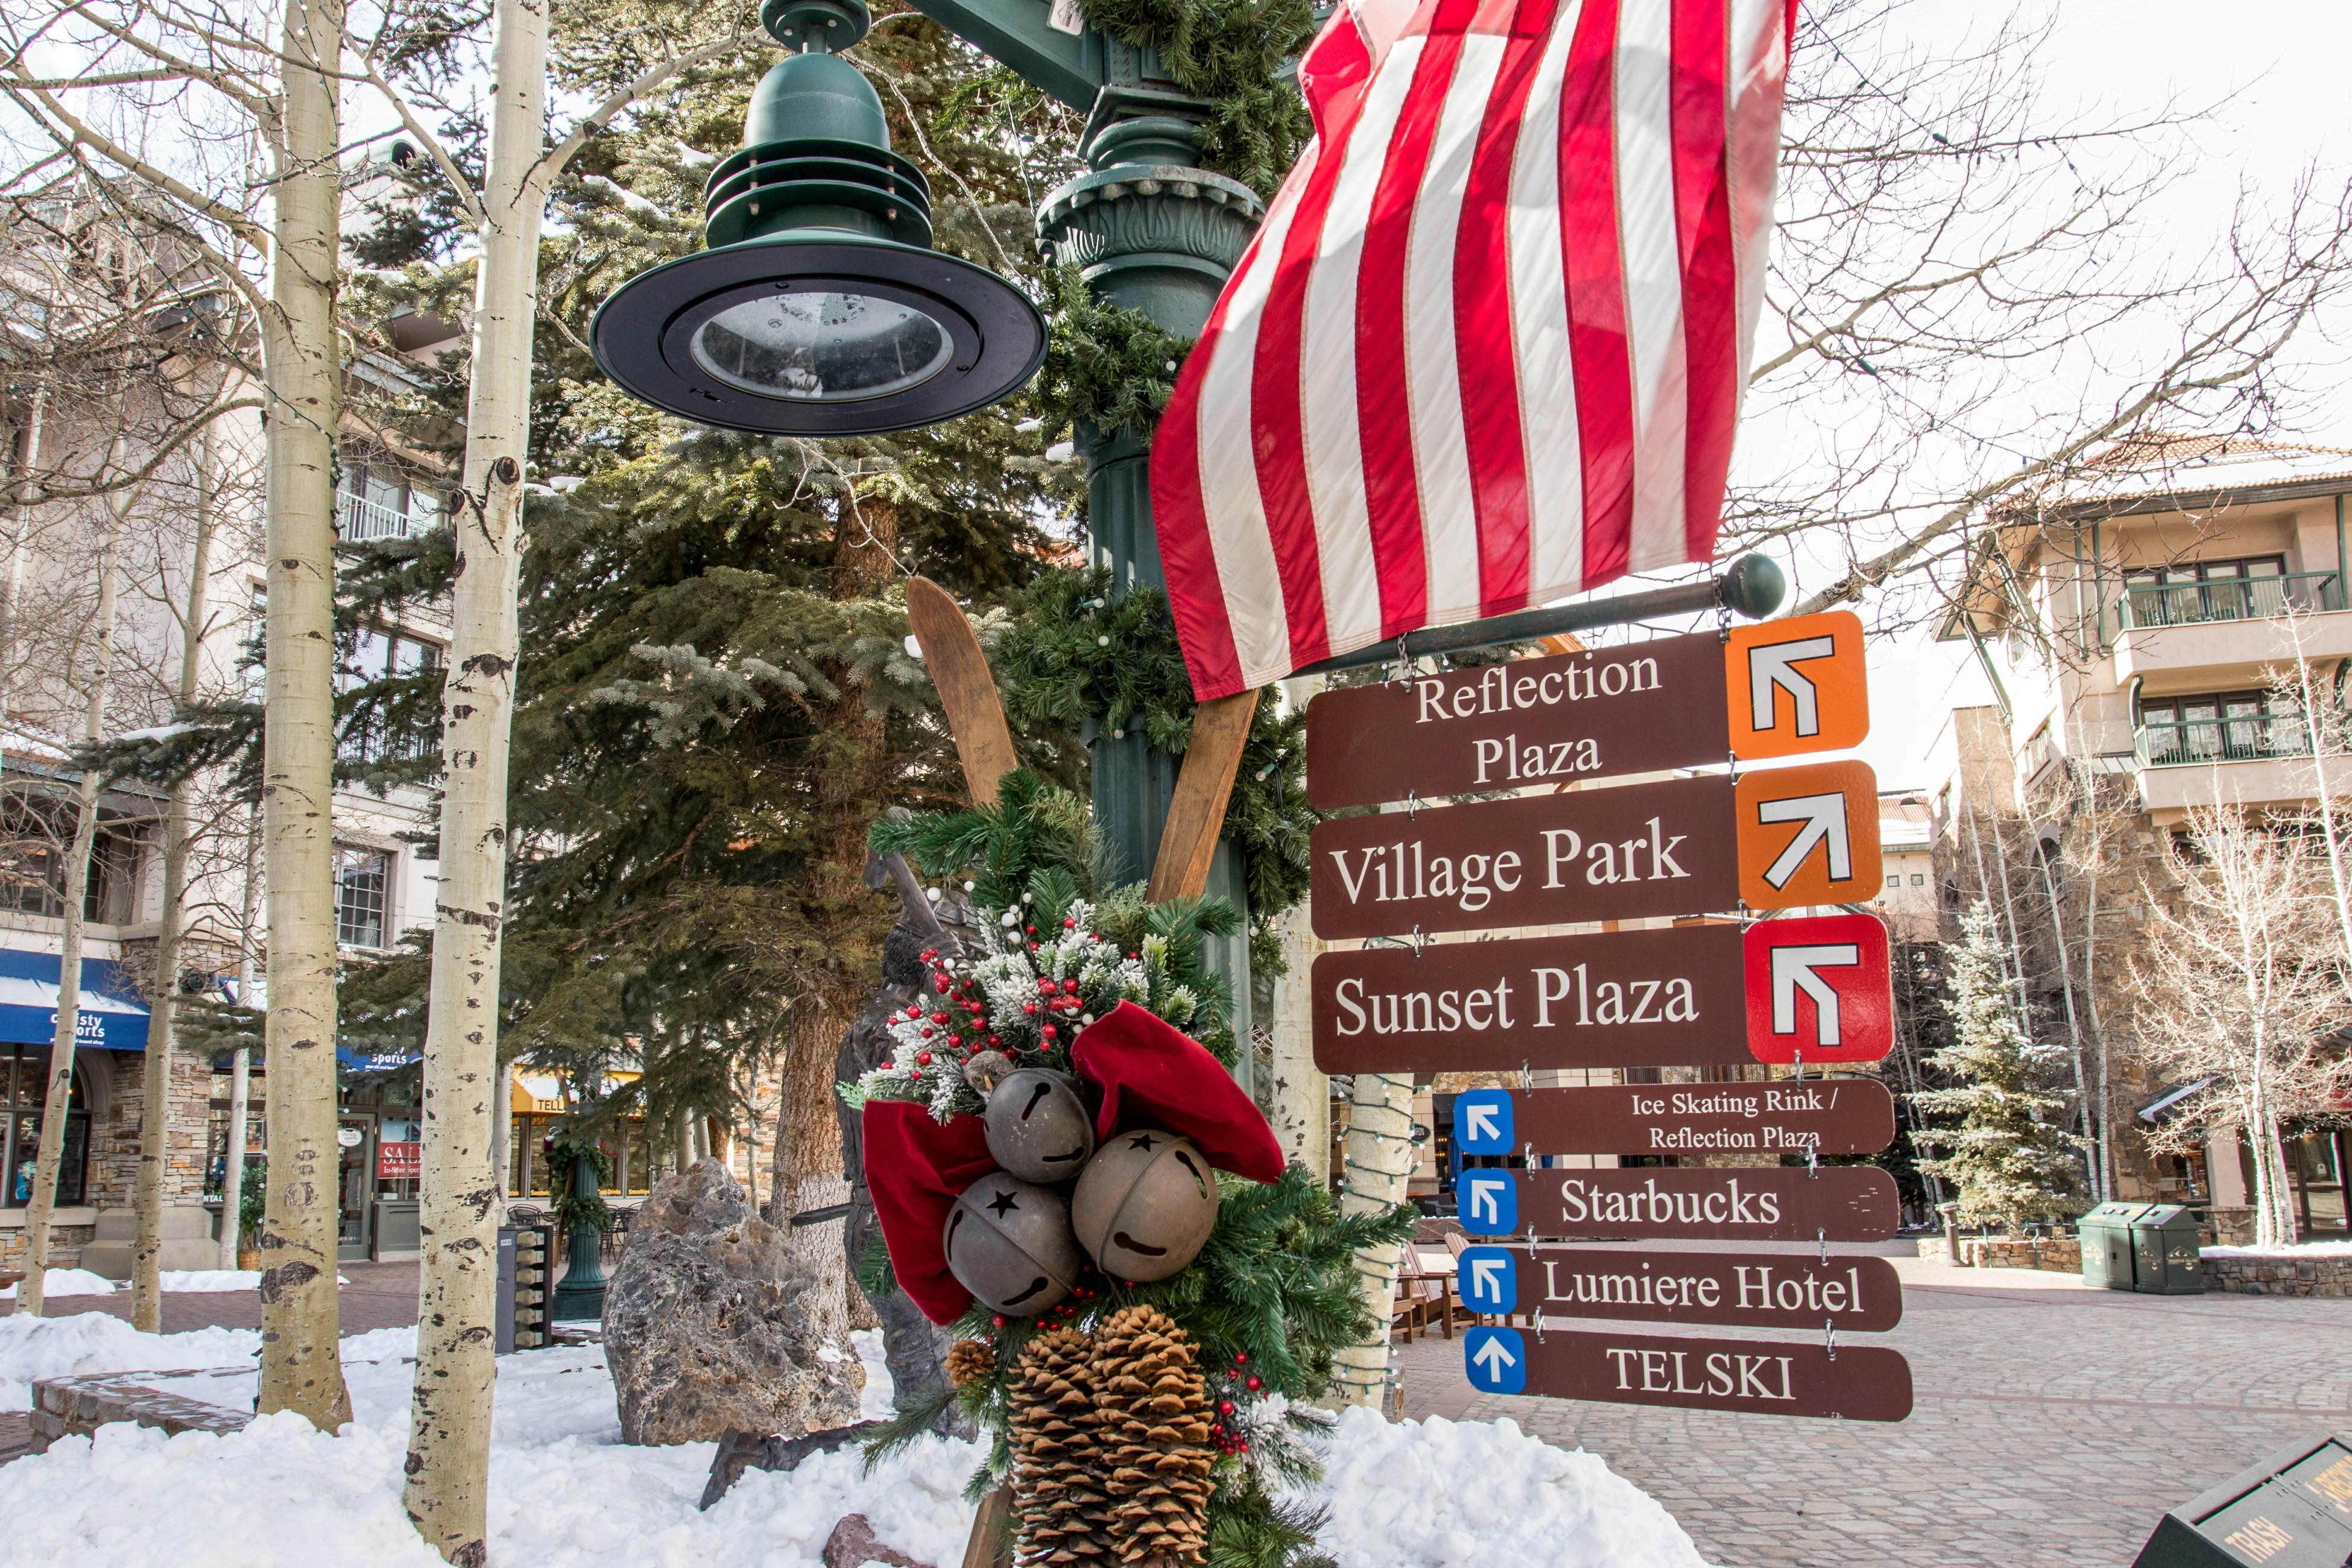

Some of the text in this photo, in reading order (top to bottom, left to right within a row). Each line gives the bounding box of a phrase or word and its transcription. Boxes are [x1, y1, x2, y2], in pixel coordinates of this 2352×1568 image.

[1415, 652, 1662, 723] Reflection
[1472, 734, 1602, 784] Plaza
[1329, 817, 1692, 911] Village Park
[1336, 963, 1700, 1035] Sunset Plaza
[77, 1026, 105, 1038] orts
[537, 1099, 563, 1111] TELL
[1632, 1087, 1838, 1118] Ice Skating Rink /
[209, 1127, 218, 1136] RON
[1649, 1127, 1821, 1148] Reflection Plaza
[1562, 1178, 1780, 1224] Starbucks
[1543, 1262, 1865, 1312] Lumiere Hotel
[1607, 1349, 1797, 1400] TELSKI
[2224, 1516, 2294, 1563] TRASH
